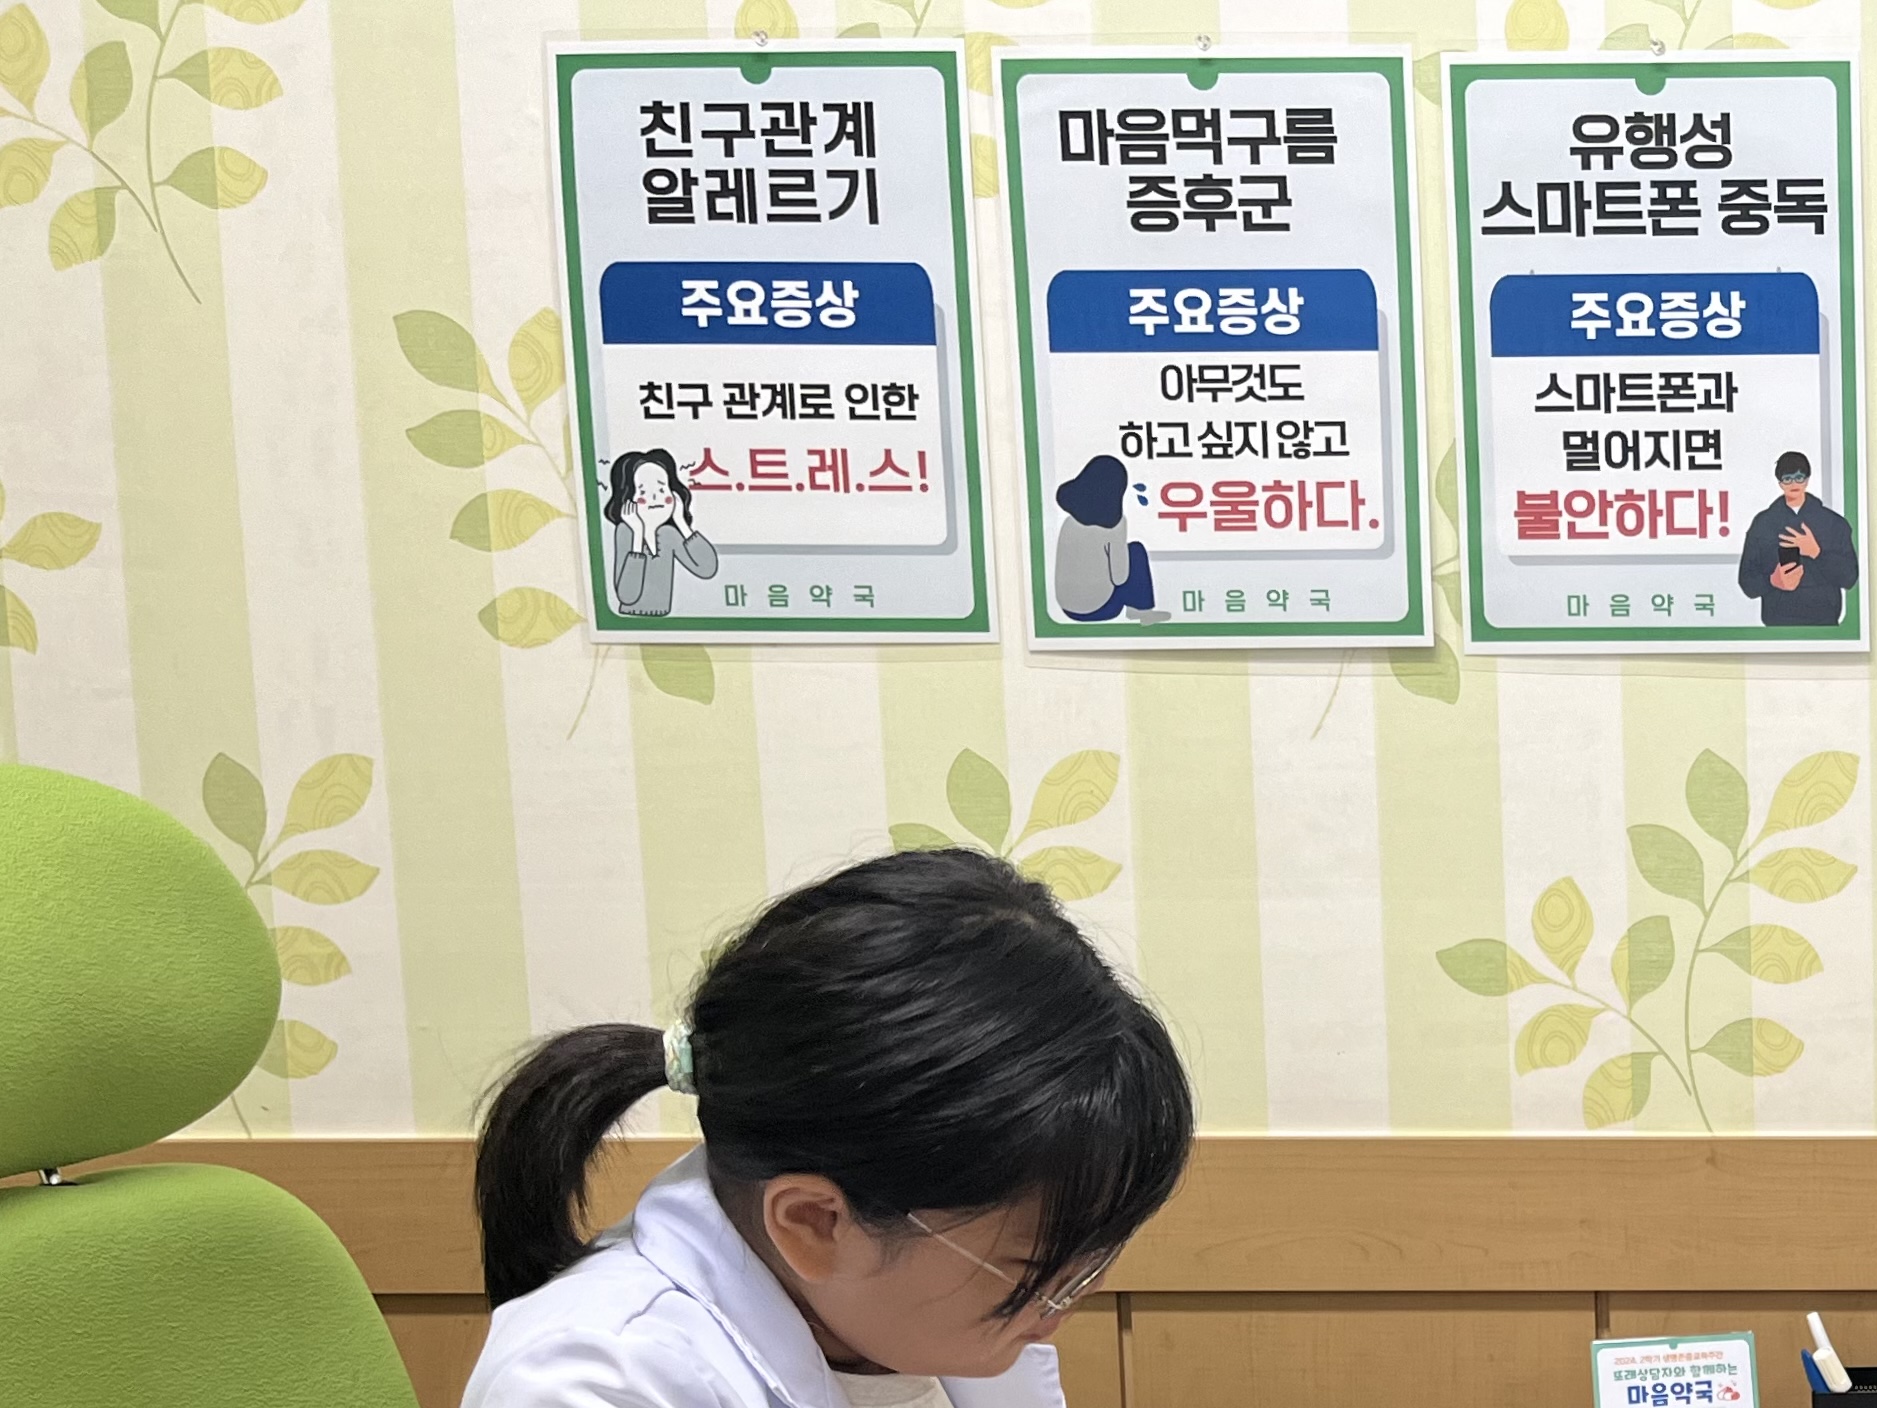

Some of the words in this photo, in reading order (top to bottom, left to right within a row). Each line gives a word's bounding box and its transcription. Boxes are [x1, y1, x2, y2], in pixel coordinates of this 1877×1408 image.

[639, 99, 877, 160] 친구관계
[1059, 107, 1338, 167] 마음먹구름
[1569, 111, 1733, 171] 유행성
[641, 165, 881, 226] 알레르기
[1126, 174, 1292, 233] 증후군
[1481, 179, 1701, 238] 스마트폰
[1718, 179, 1827, 237] 중독
[680, 280, 860, 328] 주요증상
[1127, 287, 1304, 335] 주요증상
[1569, 291, 1746, 339] 주요증상
[639, 380, 713, 421] 친구
[723, 381, 832, 422] 관계로
[844, 382, 919, 422] 인한
[1160, 365, 1305, 404] 아무것도
[1534, 372, 1739, 415] 스마트폰과
[1119, 420, 1190, 461] 하고
[1197, 418, 1270, 461] 싶지
[1276, 420, 1349, 461] 않고
[1562, 428, 1723, 472] 멀어지면
[689, 447, 928, 494] 스.트.레.스!
[1157, 480, 1380, 532] 우울하다.
[1513, 488, 1731, 541] 불안하다!
[1613, 1366, 1686, 1381] 또래상담자와
[1689, 1363, 1738, 1378] 함께하는
[1627, 1380, 1713, 1407] 마음약국
